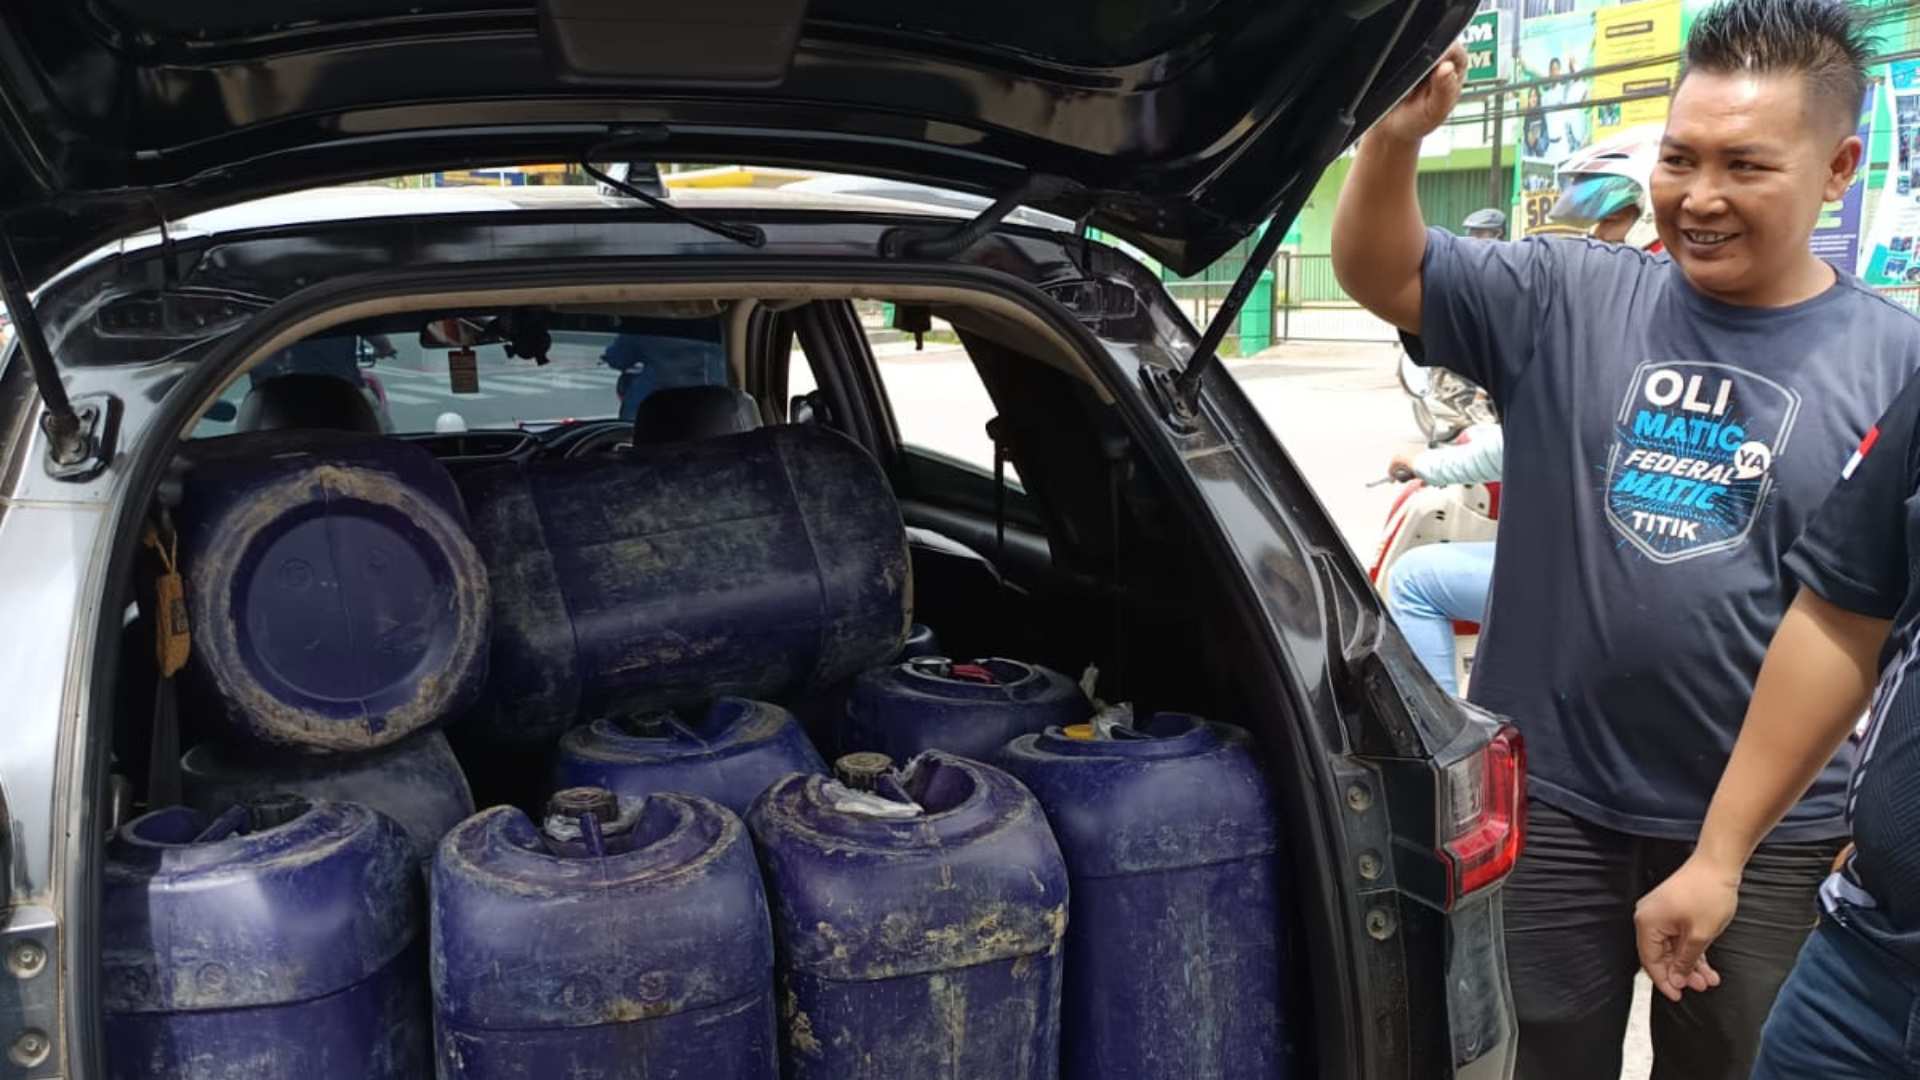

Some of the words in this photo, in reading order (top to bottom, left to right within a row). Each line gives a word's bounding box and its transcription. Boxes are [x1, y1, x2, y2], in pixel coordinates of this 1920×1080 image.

[1645, 370, 1732, 415] OLI
[1633, 410, 1744, 450] MATIC
[1625, 452, 1735, 484] FEDERAL
[1740, 451, 1766, 472] YA
[1614, 471, 1727, 509] MATIC
[1632, 512, 1699, 541] TITIK
